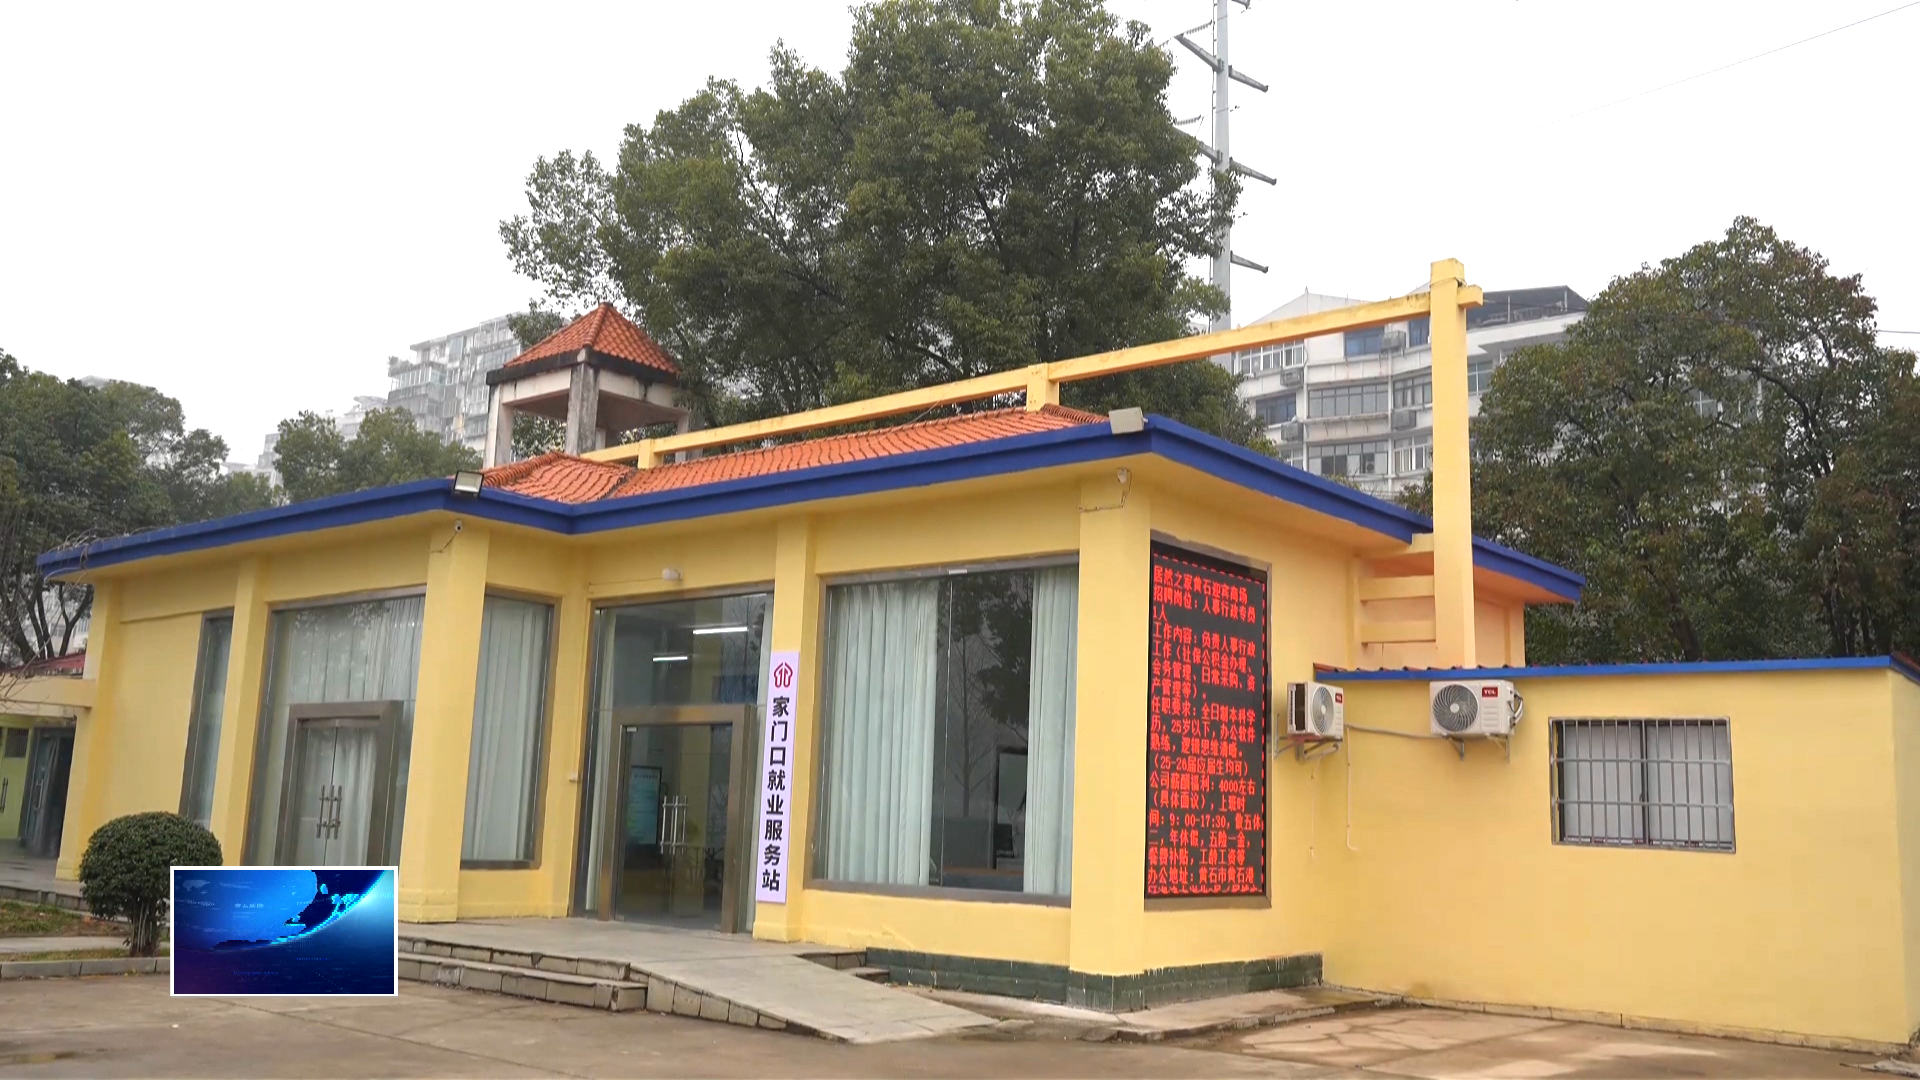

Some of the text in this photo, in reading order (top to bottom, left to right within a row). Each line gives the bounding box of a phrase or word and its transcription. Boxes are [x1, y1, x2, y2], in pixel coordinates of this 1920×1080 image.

[1153, 605, 1168, 623] 1人
[761, 696, 790, 892] 家门口就业服务站
